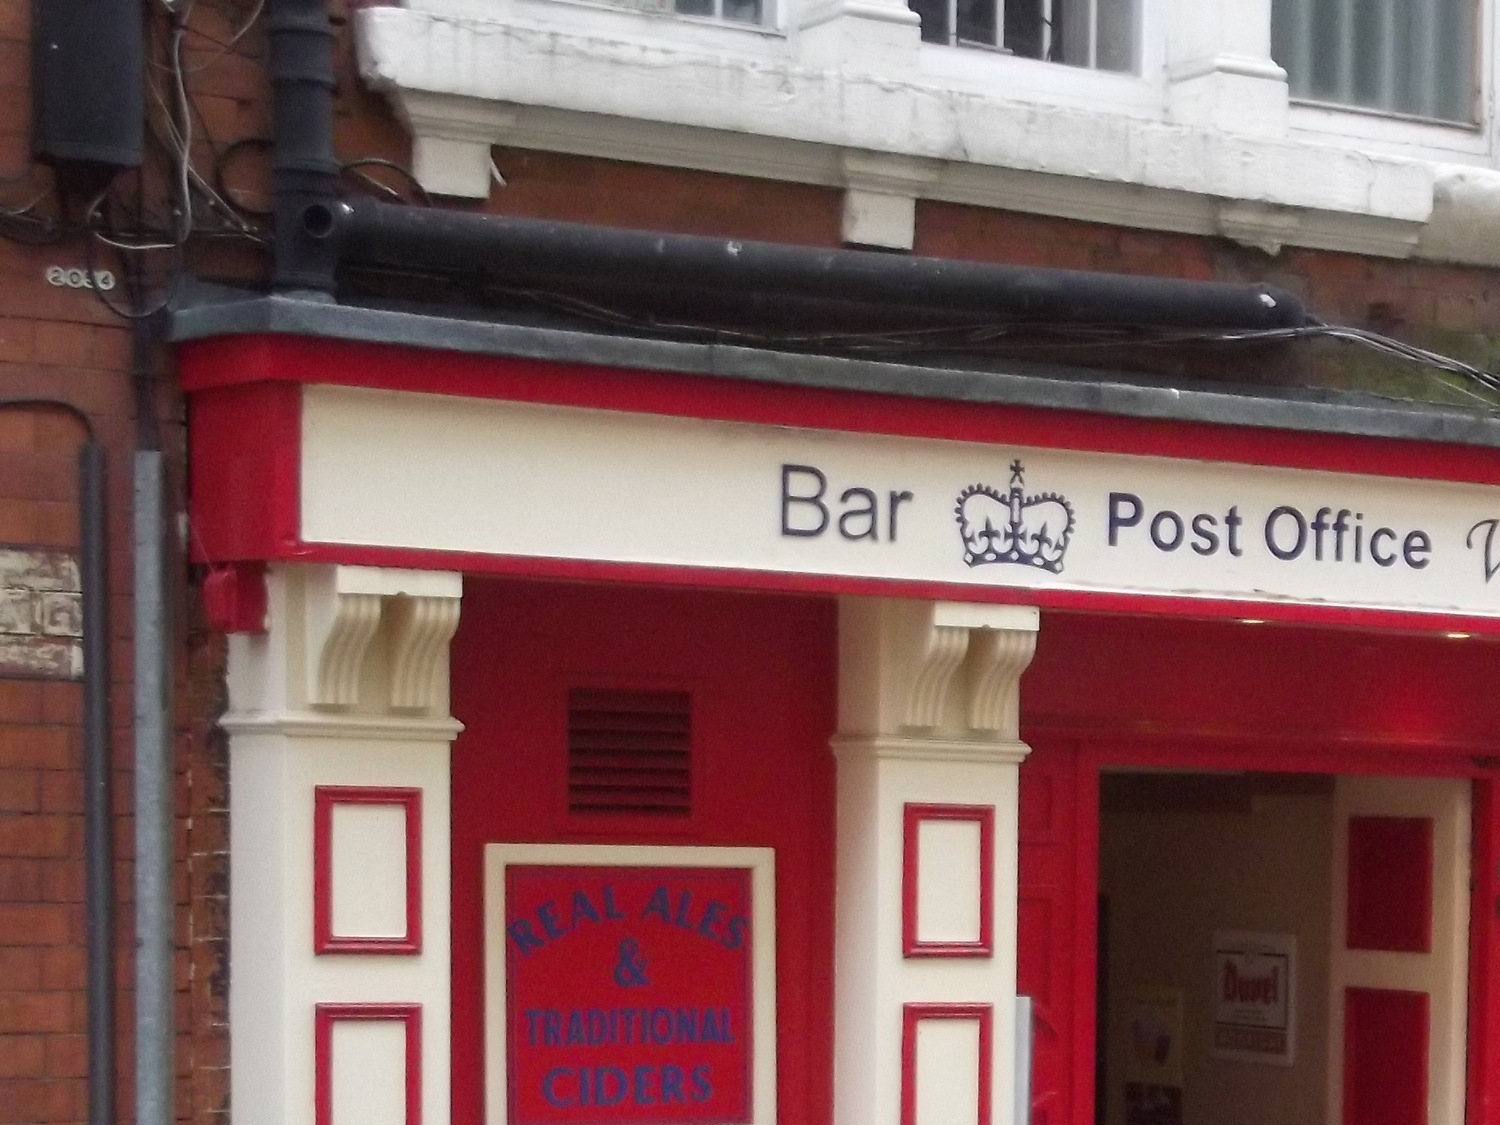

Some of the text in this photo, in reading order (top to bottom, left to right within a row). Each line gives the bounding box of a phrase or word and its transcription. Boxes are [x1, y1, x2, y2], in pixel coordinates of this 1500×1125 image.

[780, 463, 914, 543] Bar
[1107, 491, 1243, 557] Post
[1264, 504, 1433, 570] Office
[506, 885, 750, 956] REAL ALES
[613, 936, 651, 988] &
[523, 1006, 736, 1047] TRADITIONAL
[542, 1064, 714, 1108] CIDERS
